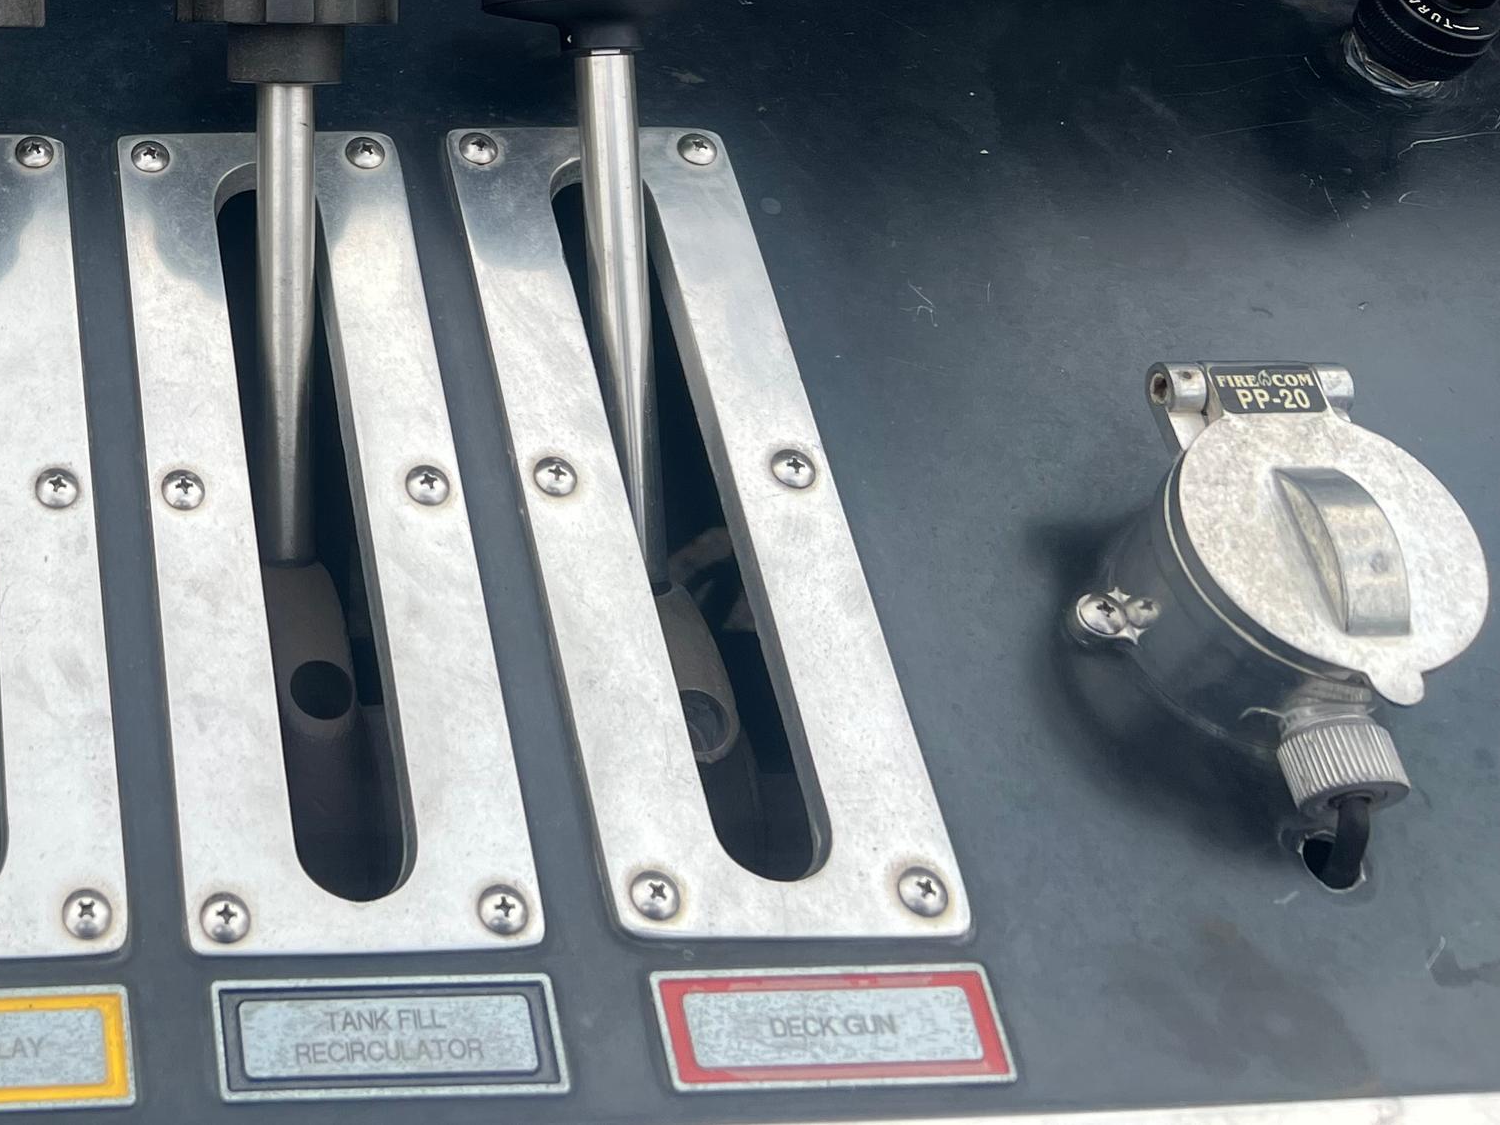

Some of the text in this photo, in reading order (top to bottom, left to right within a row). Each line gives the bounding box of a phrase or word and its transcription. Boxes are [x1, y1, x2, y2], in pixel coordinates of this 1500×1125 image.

[1235, 389, 1311, 409] PP-20
[326, 1008, 448, 1032] TANK FILL
[771, 1013, 898, 1039] DECK GUN
[295, 1038, 485, 1065] RECIRCULATOR
